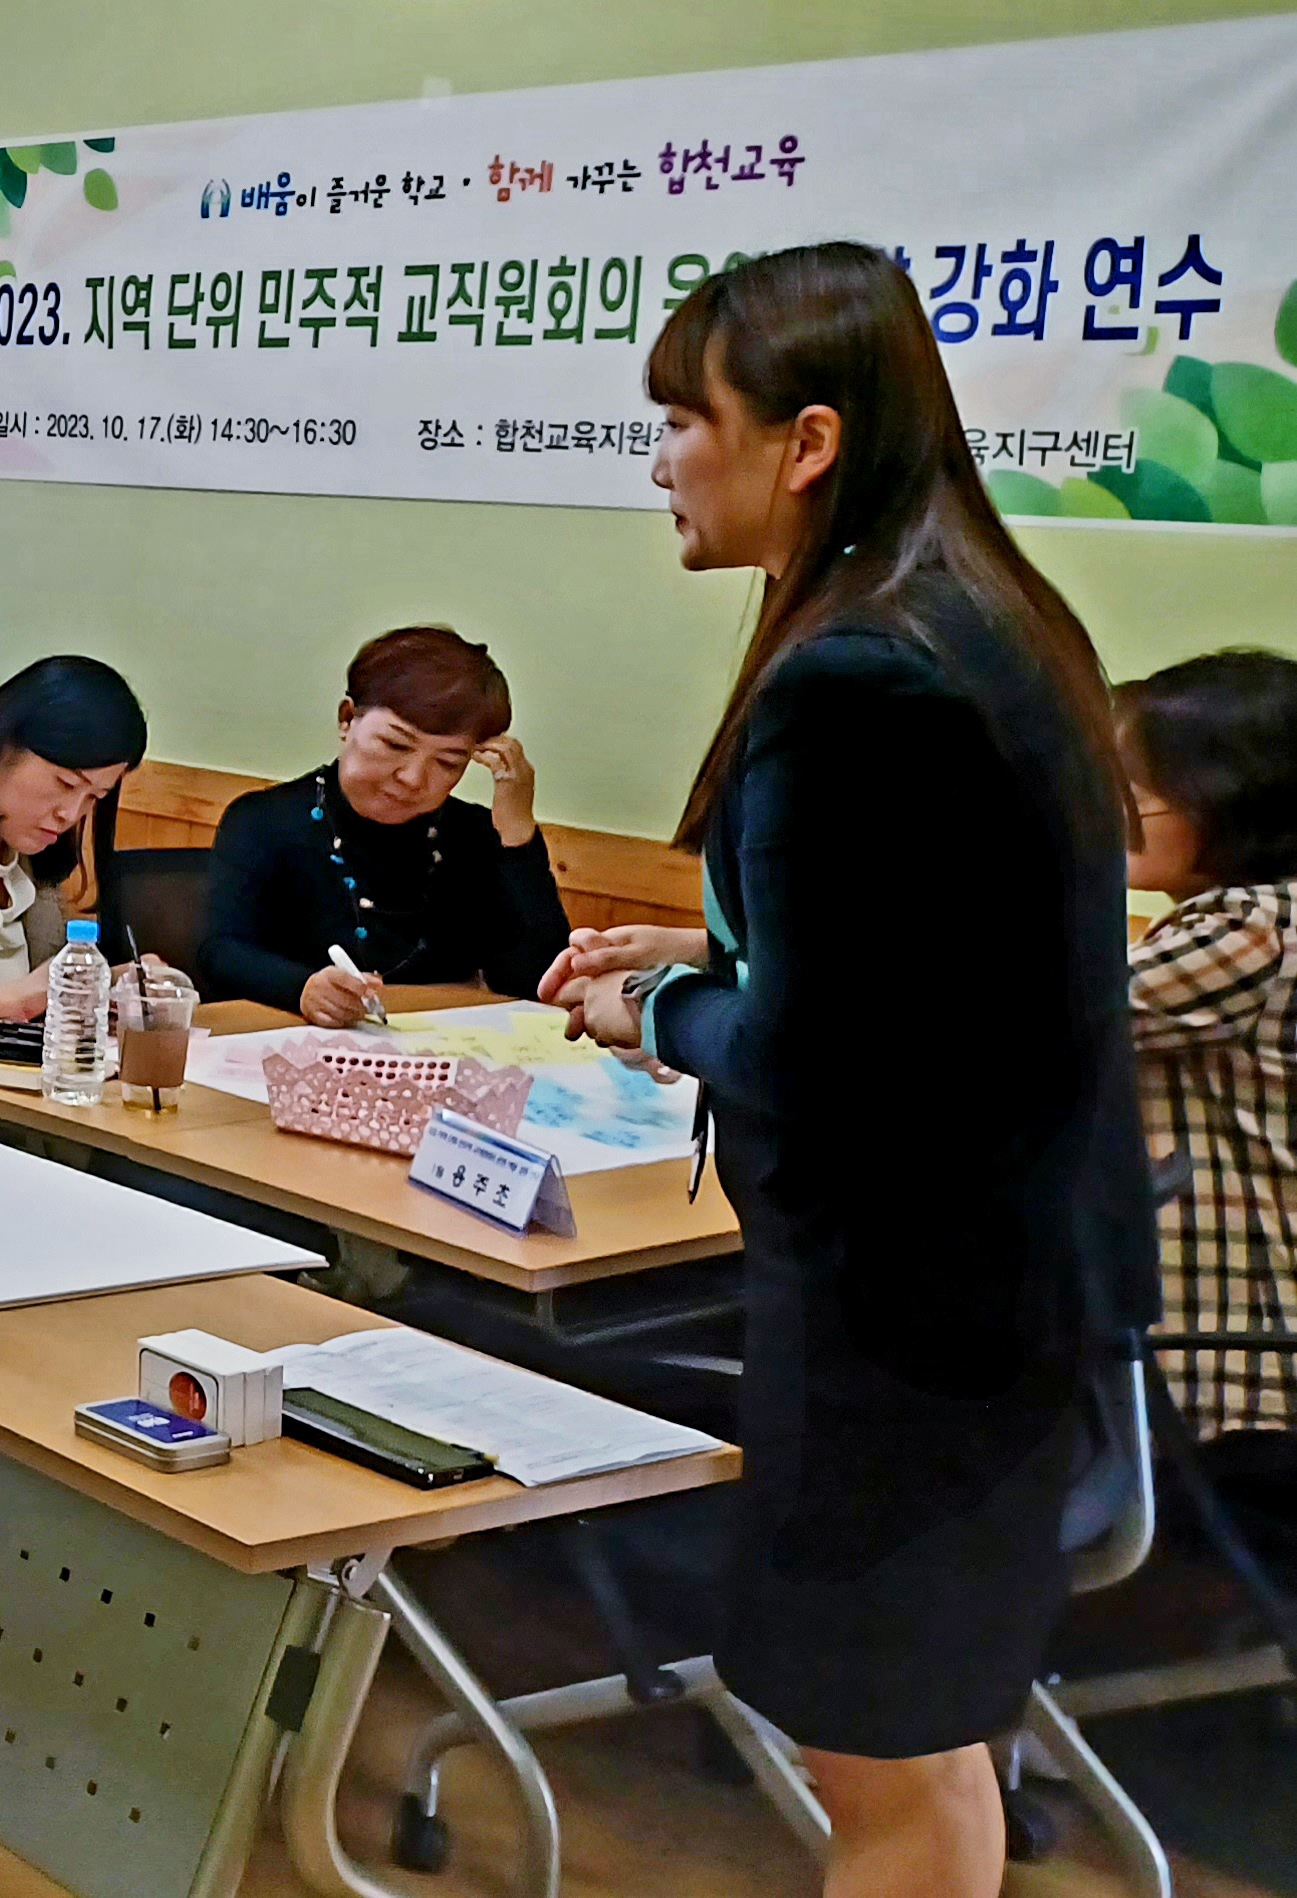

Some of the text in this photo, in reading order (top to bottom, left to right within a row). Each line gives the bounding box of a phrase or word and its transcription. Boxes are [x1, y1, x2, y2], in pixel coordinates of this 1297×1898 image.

[241, 172, 316, 216] 배움이
[327, 174, 391, 214] 즐거운
[402, 171, 446, 206] 학교
[488, 154, 554, 202] 함께
[566, 159, 642, 194] 가꾸는
[658, 134, 806, 195] 합천교육
[83, 273, 154, 350] 지역
[167, 269, 244, 350] 단위
[257, 264, 384, 349] 민주적
[397, 255, 643, 347] 교직원회의
[929, 238, 1060, 344] 강화
[1082, 234, 1223, 341] 연수
[46, 413, 94, 441] 2023.
[102, 415, 129, 442] 10.
[137, 412, 203, 444] 17.(화)
[210, 416, 358, 446] 14:30~16:30
[418, 418, 465, 451] 장소
[494, 418, 666, 456] 합천교육지원
